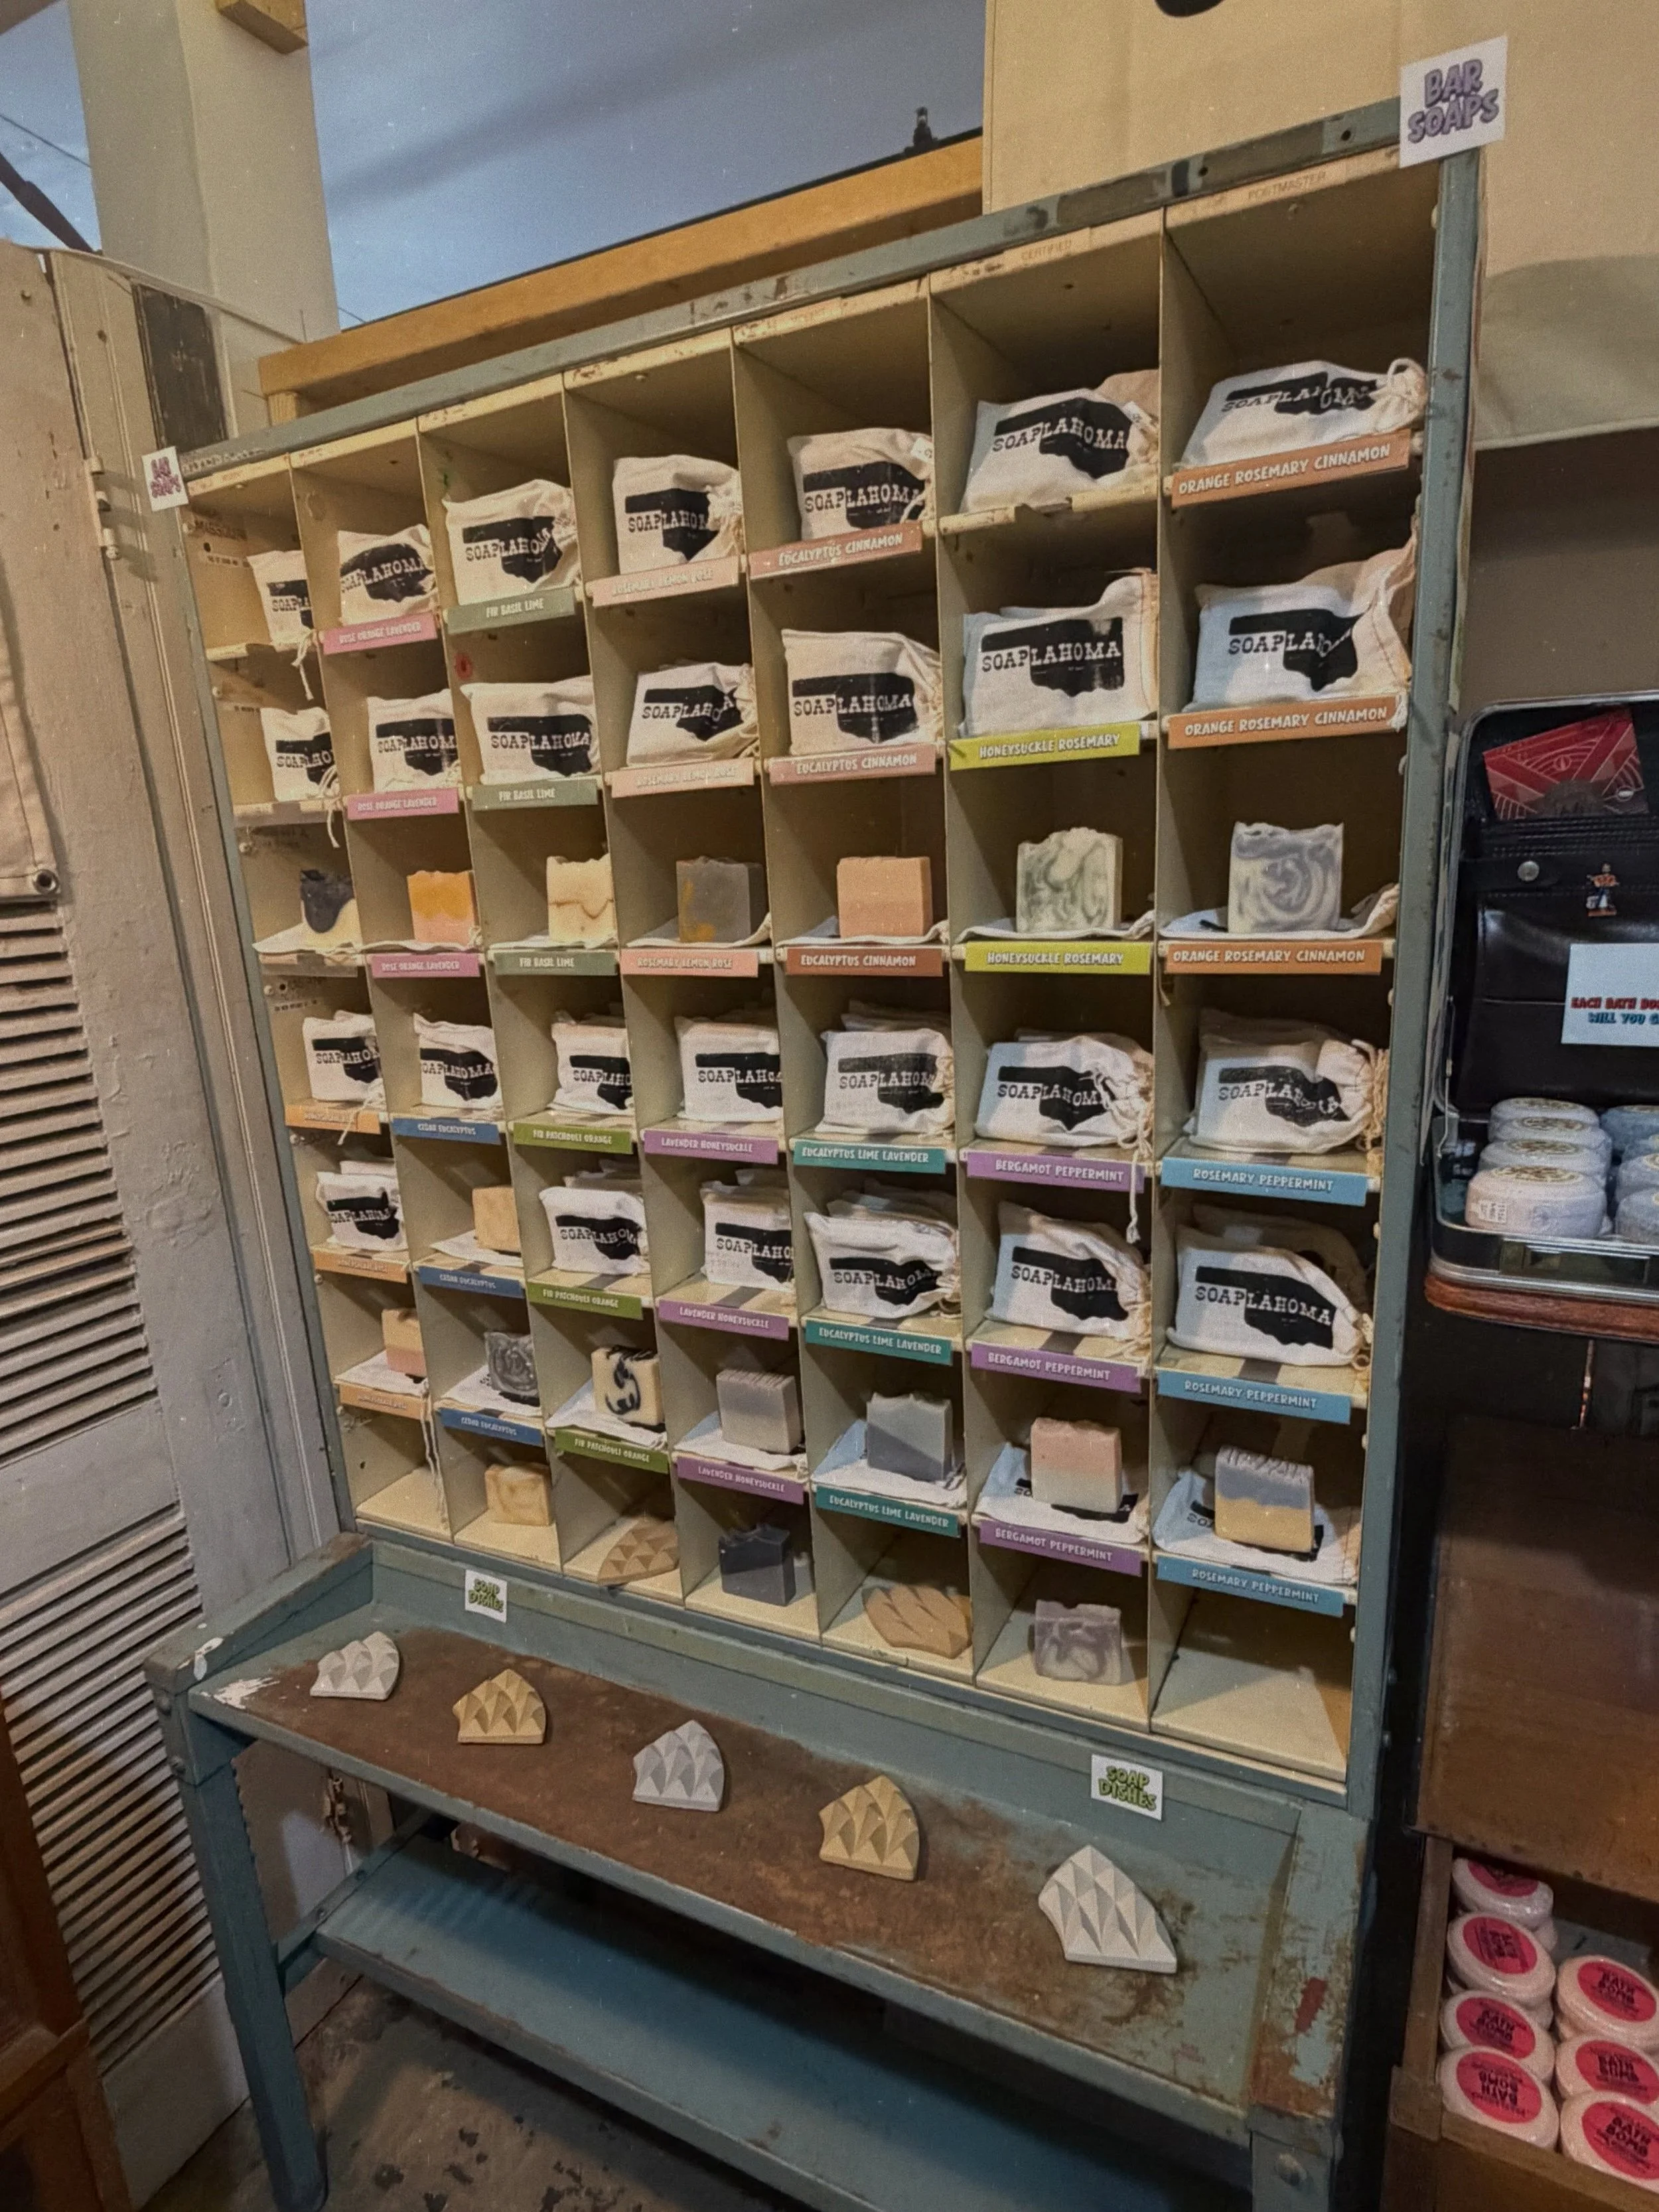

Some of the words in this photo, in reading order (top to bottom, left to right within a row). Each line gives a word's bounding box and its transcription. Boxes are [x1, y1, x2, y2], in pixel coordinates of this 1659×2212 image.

[1425, 58, 1484, 108] BAR
[1407, 88, 1499, 143] SOAPS
[993, 415, 1129, 451] SOAPLAHOMA
[1179, 473, 1230, 494] ORANGE
[1236, 461, 1308, 485] ROSEMARY
[1315, 445, 1390, 469] CINNAMON
[466, 528, 550, 561] SOAPLAHOMA
[779, 546, 840, 565] EUCALYPTUS
[846, 534, 902, 554] CINNAMON
[525, 599, 543, 611] LIME
[981, 641, 1122, 672] SOAPLAHOMA
[794, 694, 914, 717] SOAPLAHOMA
[1185, 719, 1235, 736] ORANGE
[1240, 713, 1309, 731] ROSEMARY
[1315, 706, 1387, 725] CINNAMON
[491, 732, 590, 749] SOAPLAHOMA
[979, 739, 1054, 758] HONEYSUCKLE
[1058, 732, 1120, 753] ROSEMARY
[797, 760, 858, 775] EUCALYPTUS
[862, 754, 916, 769] CINNAMON
[537, 788, 556, 798] LIME
[556, 957, 575, 968] LIME
[801, 954, 859, 966] EUCALYPTUS
[863, 955, 916, 967] CINNAMON
[987, 952, 1060, 966] HONEYSUCKLE
[1064, 952, 1123, 966] ROSEMARY
[1173, 949, 1220, 963] ORANGE
[1224, 948, 1291, 963] ROSEMARY
[1297, 948, 1365, 963] CINNAMON
[1621, 1013, 1646, 1025] YOU
[661, 1137, 697, 1149] LAVENDER
[700, 1140, 753, 1153] HONEYSUCKLE
[802, 1147, 855, 1160] EUCALYPTUS
[857, 1148, 879, 1161] LIME
[882, 1149, 929, 1163] LAVENDER
[995, 1160, 1050, 1177] BERGAMOT
[1056, 1164, 1123, 1182] PEPPERMINT
[1193, 1169, 1255, 1185] ROSEMARY
[1260, 1174, 1334, 1192] PEPPERMINT
[680, 1307, 716, 1321] LAVENDER
[717, 1312, 769, 1329] HONEYSUCKLE
[1194, 1286, 1332, 1325] SOAPLAHOMA
[818, 1327, 871, 1344] EUCALYPTUS
[873, 1334, 893, 1347] LIME
[897, 1337, 942, 1355] LAVENDER
[988, 1353, 1041, 1370] BERGAMOT
[1045, 1360, 1111, 1380] PEPPERMINT
[1185, 1380, 1244, 1400] ROSEMARY
[1247, 1388, 1317, 1410] PEPPERMINT
[575, 1437, 585, 1447] FIR
[587, 1439, 621, 1456] PATCHOULI
[623, 1447, 650, 1463] ORANGE
[698, 1465, 733, 1481] LAVENDER
[735, 1473, 785, 1493] HONEYSUCKLE
[830, 1495, 879, 1514] EUCALYPTUS
[882, 1505, 902, 1517] LIME
[905, 1509, 949, 1527] LAVENDER
[995, 1528, 1046, 1549] BERGAMOT
[1050, 1538, 1112, 1562] PEPPERMINT
[1192, 1569, 1249, 1589] ROSEMARY
[1252, 1582, 1319, 1604] PEPPERMINT
[1106, 1765, 1150, 1789] SOAP
[1098, 1778, 1157, 1811] DISHES
